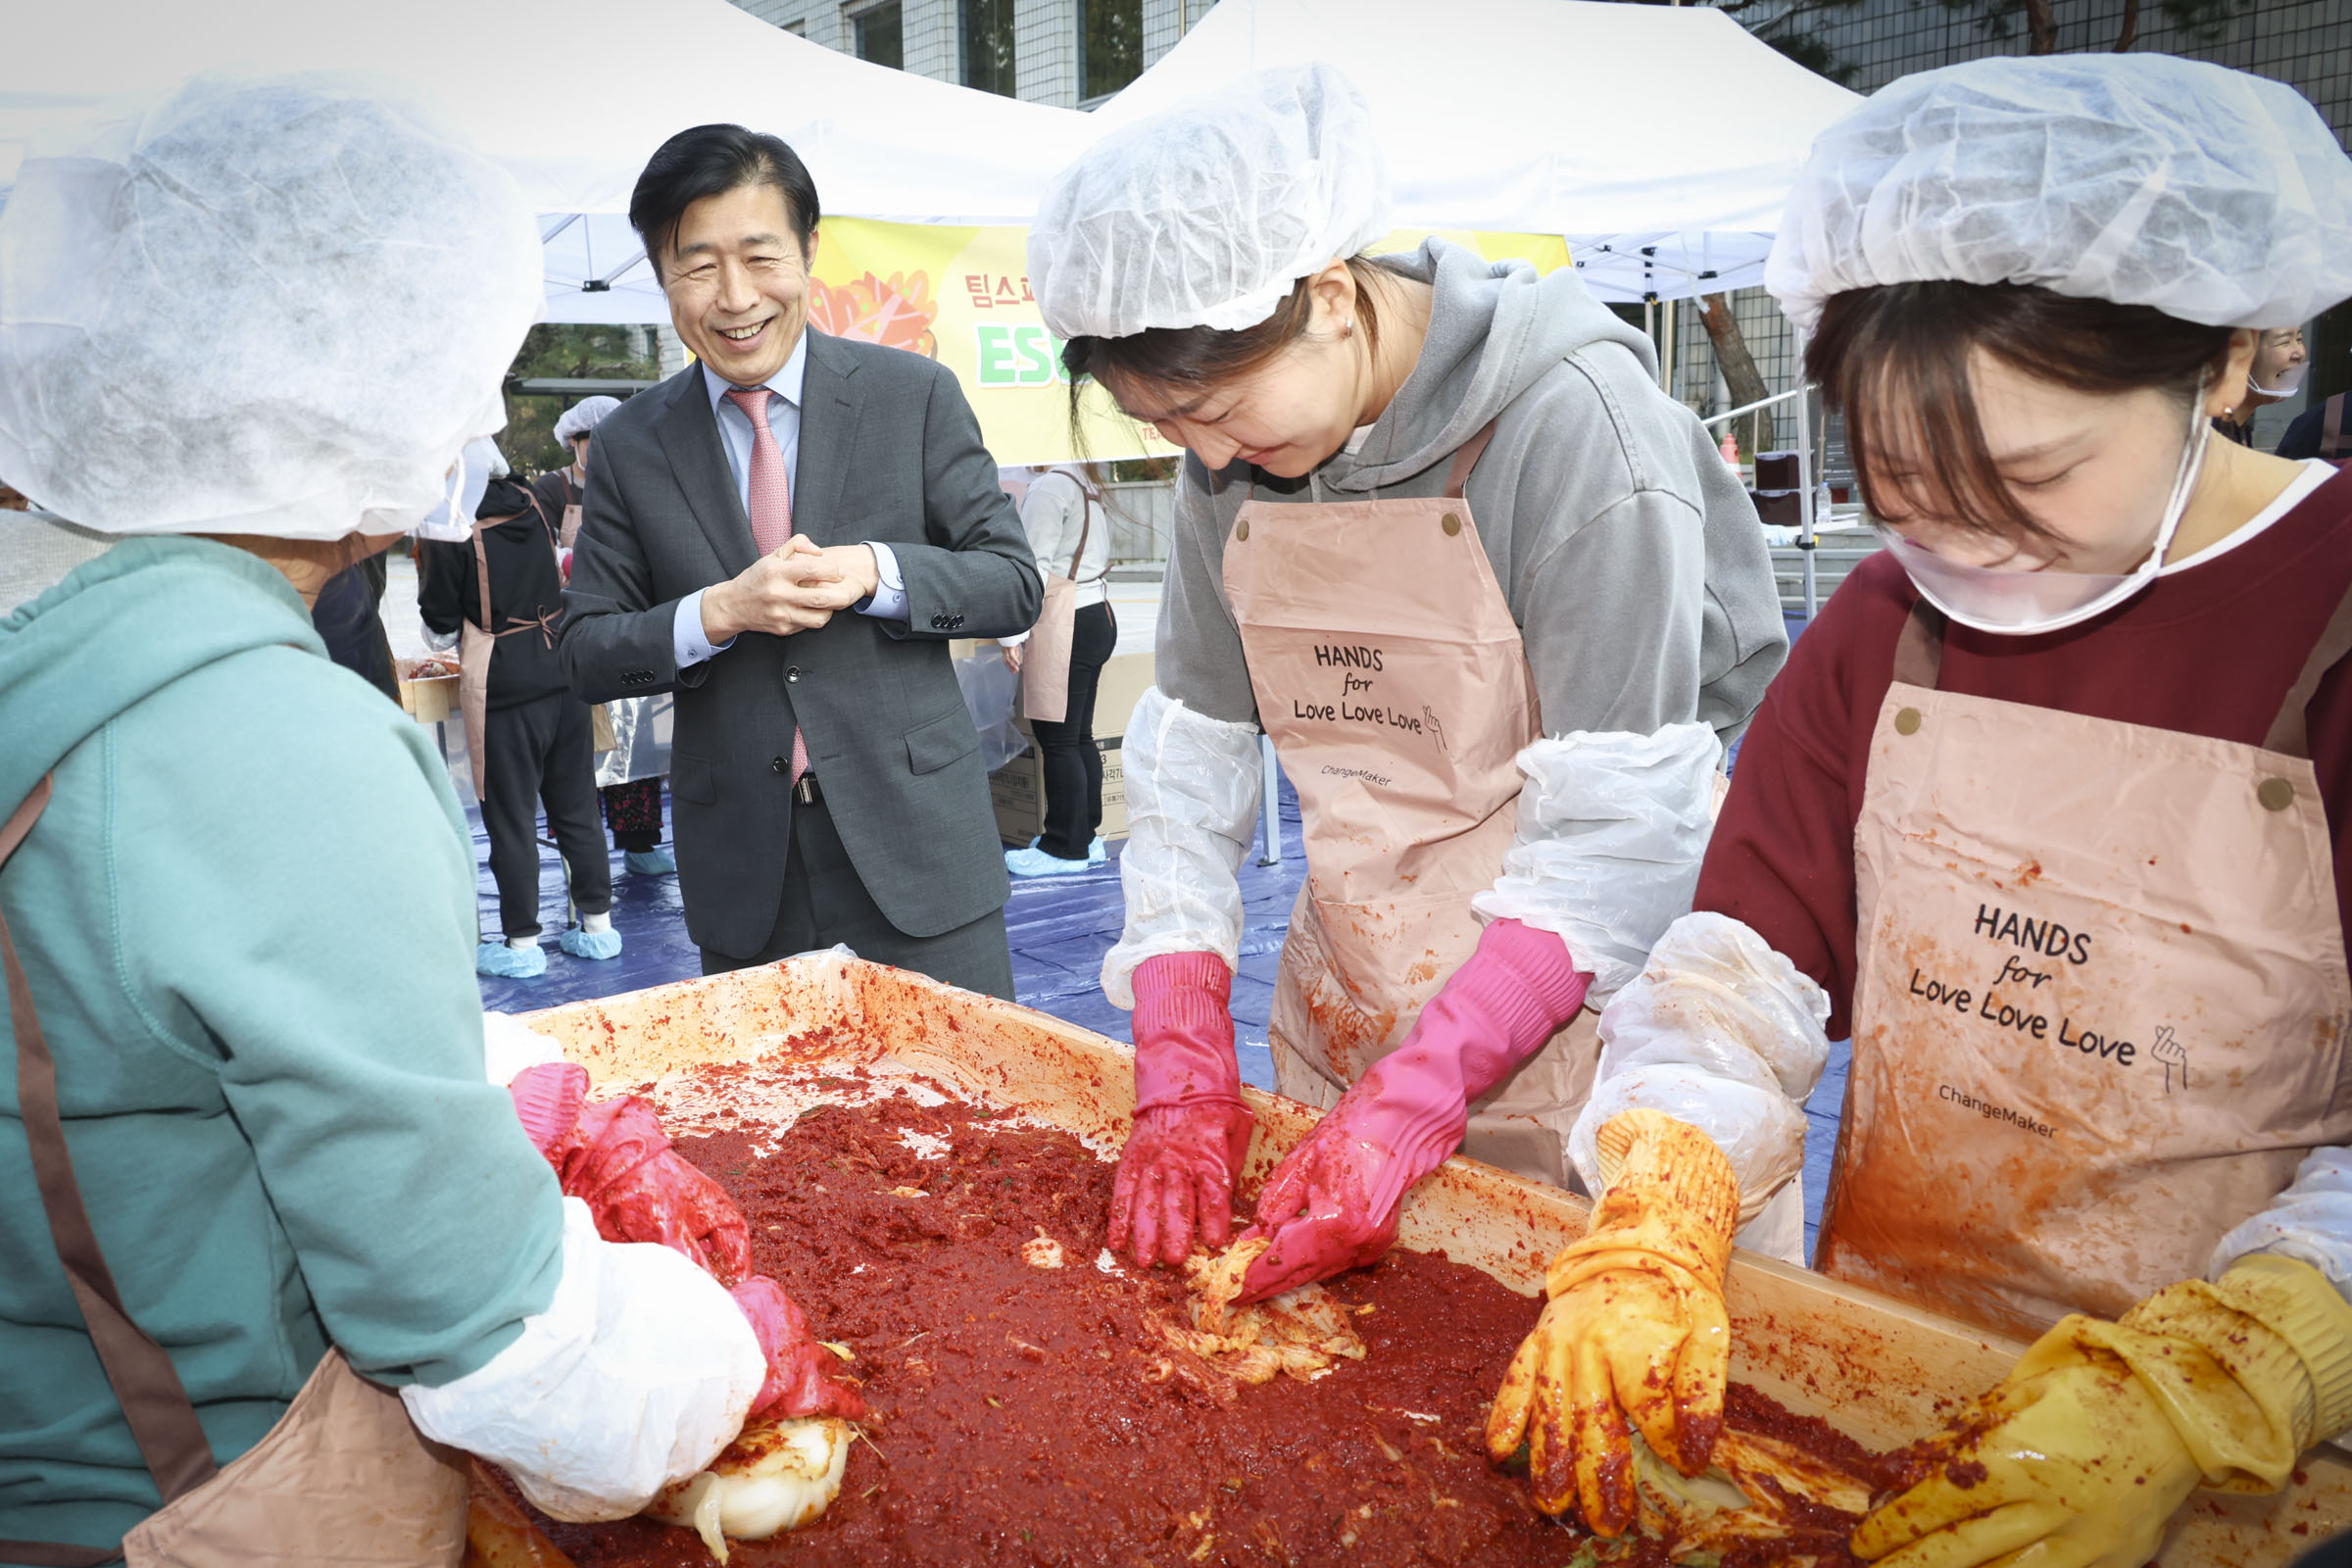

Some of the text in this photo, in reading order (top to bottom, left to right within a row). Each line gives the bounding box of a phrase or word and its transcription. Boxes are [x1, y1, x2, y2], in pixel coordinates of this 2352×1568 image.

[1314, 645, 1383, 671] HANDS
[1343, 672, 1373, 696] for
[1294, 700, 1422, 735] Love Love Love
[1321, 764, 1392, 787] ChangeMaker
[1975, 904, 2091, 965] HANDS
[1992, 956, 2052, 989] for
[1909, 968, 2136, 1066] Love Love Love
[1938, 1084, 2059, 1139] ChangeMaker
